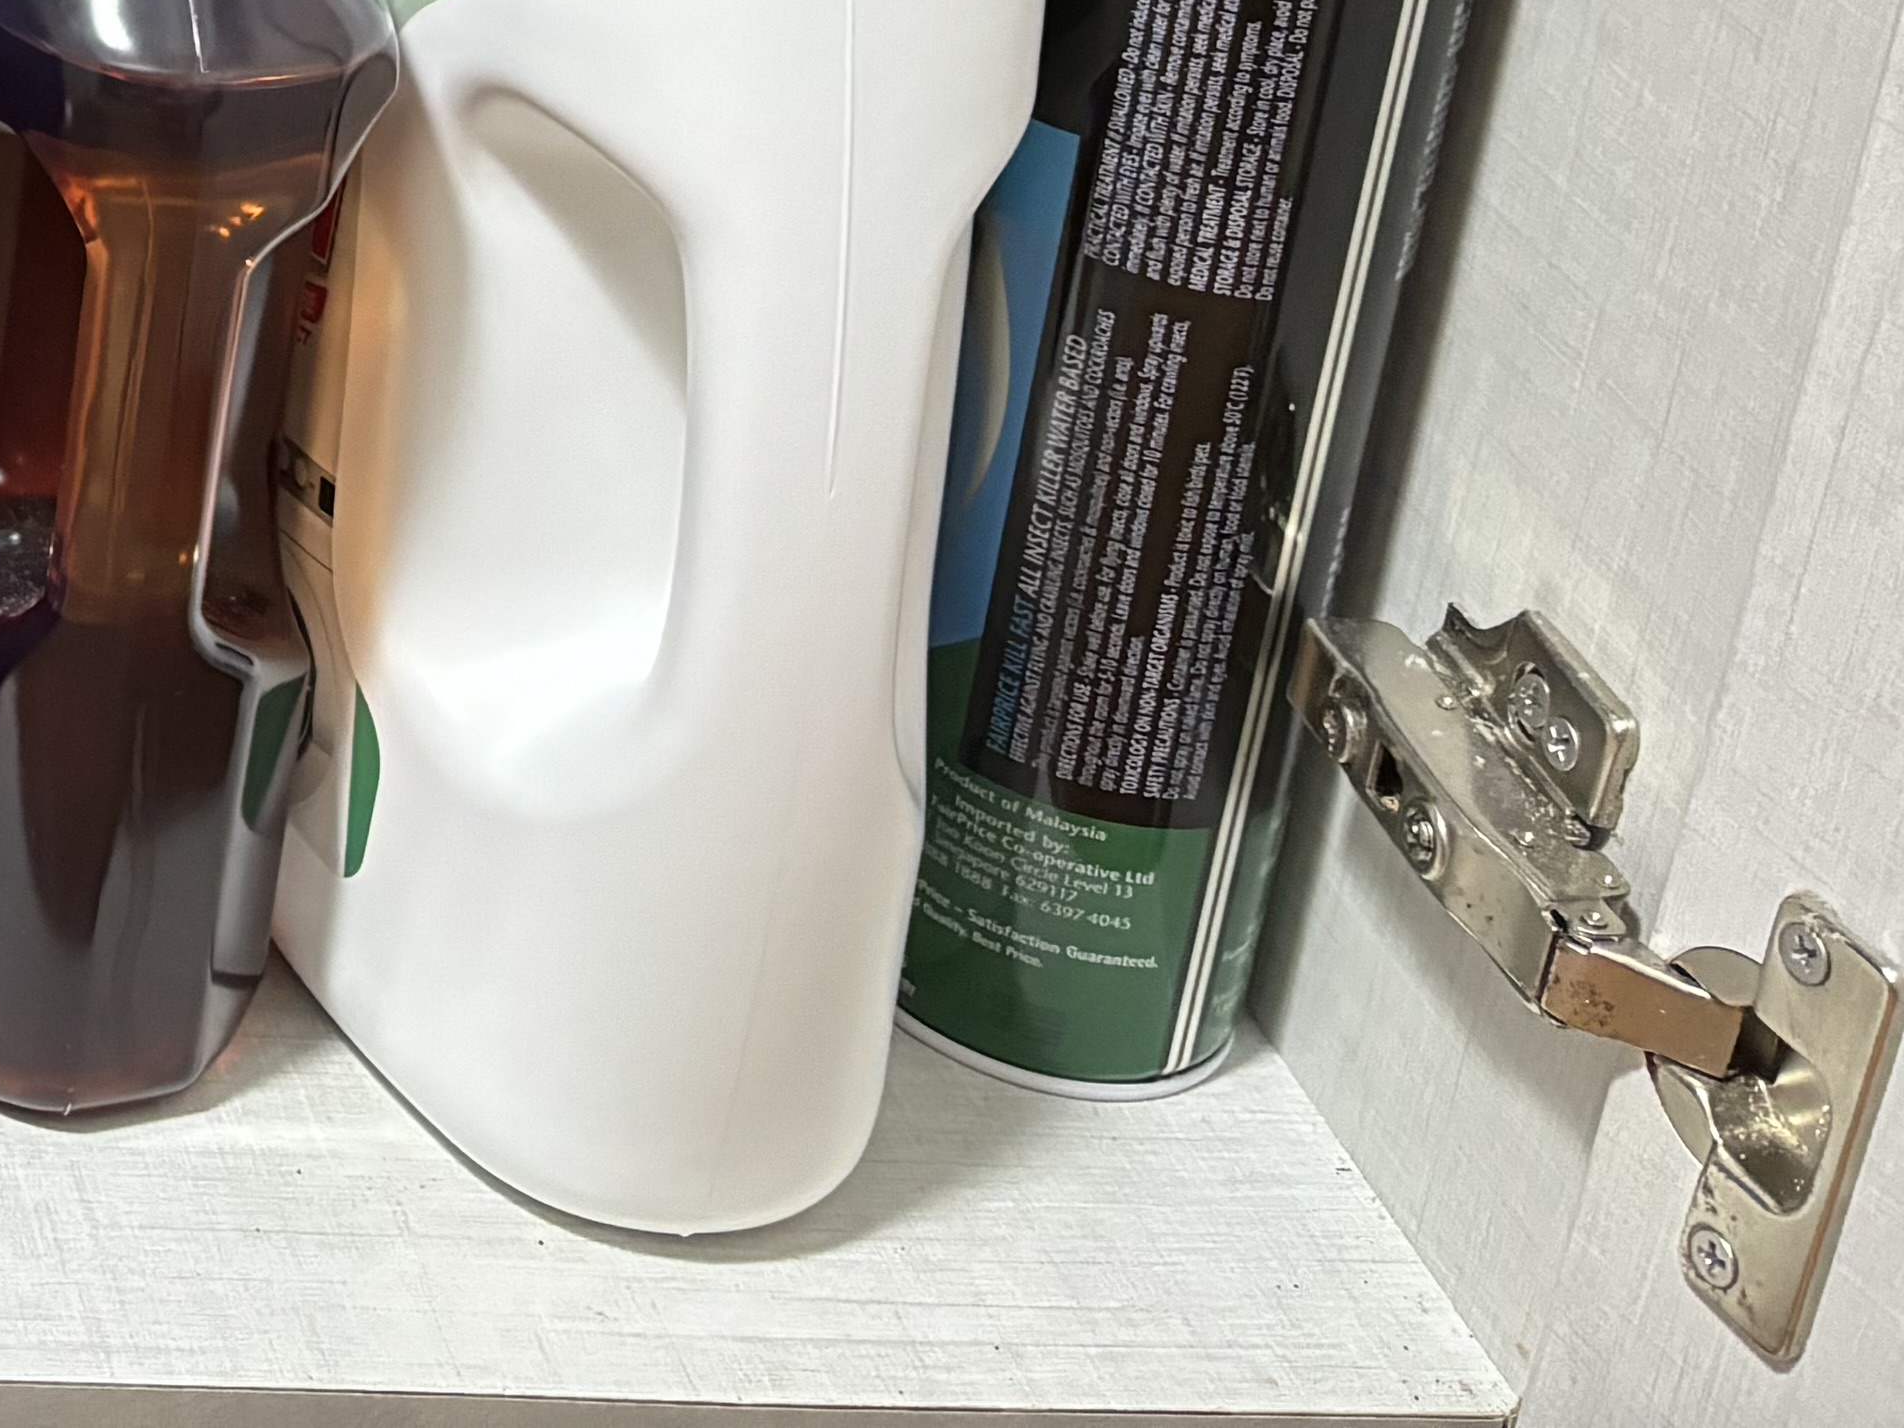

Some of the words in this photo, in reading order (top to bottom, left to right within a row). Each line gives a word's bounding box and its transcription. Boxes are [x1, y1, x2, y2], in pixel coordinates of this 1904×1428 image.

[1236, 142, 1261, 189] STORAGE
[1197, 183, 1226, 246] TREATMENT
[1226, 190, 1251, 238] DISPOSAL
[1188, 246, 1214, 291] MEDICAL
[1213, 248, 1239, 296] STORAGE
[1058, 334, 1087, 391] BASED
[1046, 390, 1077, 448] WATER
[1035, 449, 1065, 507] KILLER
[1023, 503, 1054, 566] INSECT
[1018, 566, 1042, 598] ALL
[1009, 594, 1037, 639] FAST
[1002, 640, 1029, 676] KILL
[986, 672, 1021, 756] FAIRPRICE
[934, 757, 995, 803] Product
[1001, 797, 1020, 813] of
[1025, 806, 1107, 842] Malaysia
[1143, 760, 1166, 800] SAFETY
[955, 794, 1036, 843] Imported
[1042, 834, 1071, 855] by:
[1001, 836, 1121, 883] Co-operative
[1125, 870, 1155, 885] Ltd
[1015, 874, 1078, 903] 629117
[1064, 874, 1109, 896] Level
[1114, 884, 1133, 900] 13
[967, 908, 1061, 954] Satisfaction
[1040, 898, 1086, 921] 6397
[1087, 912, 1132, 930] 4045
